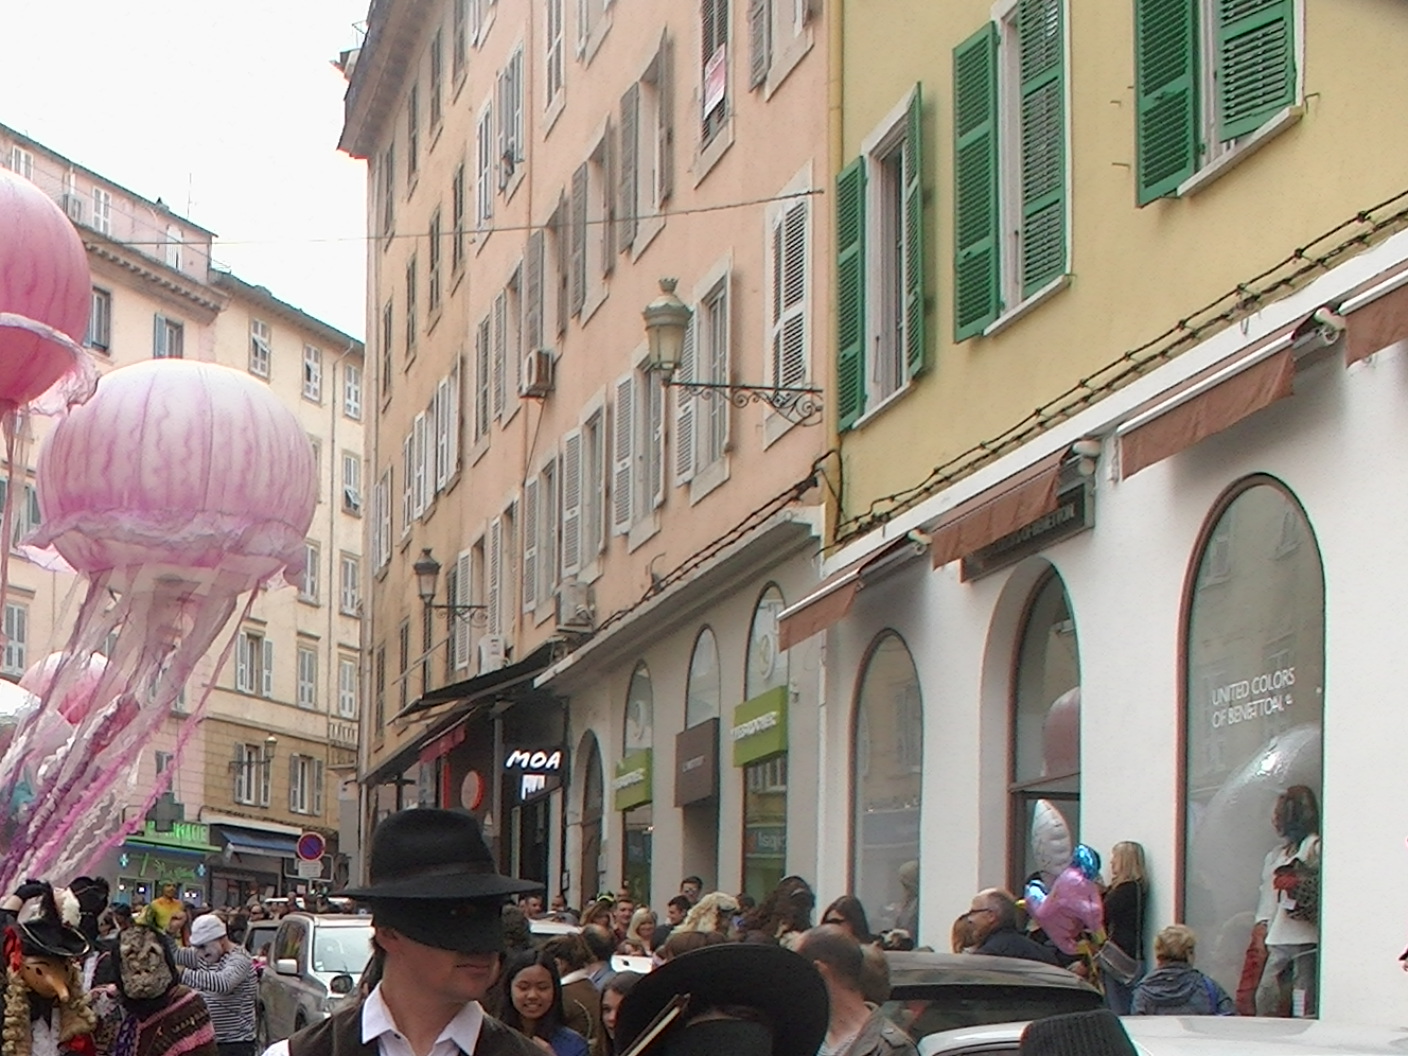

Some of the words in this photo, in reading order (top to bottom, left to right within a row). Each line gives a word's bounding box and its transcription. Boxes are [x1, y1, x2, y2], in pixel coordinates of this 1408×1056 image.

[1212, 680, 1250, 705] UNITED
[1252, 667, 1296, 694] COLORS
[1212, 708, 1226, 728] OF
[505, 750, 562, 770] MOA
